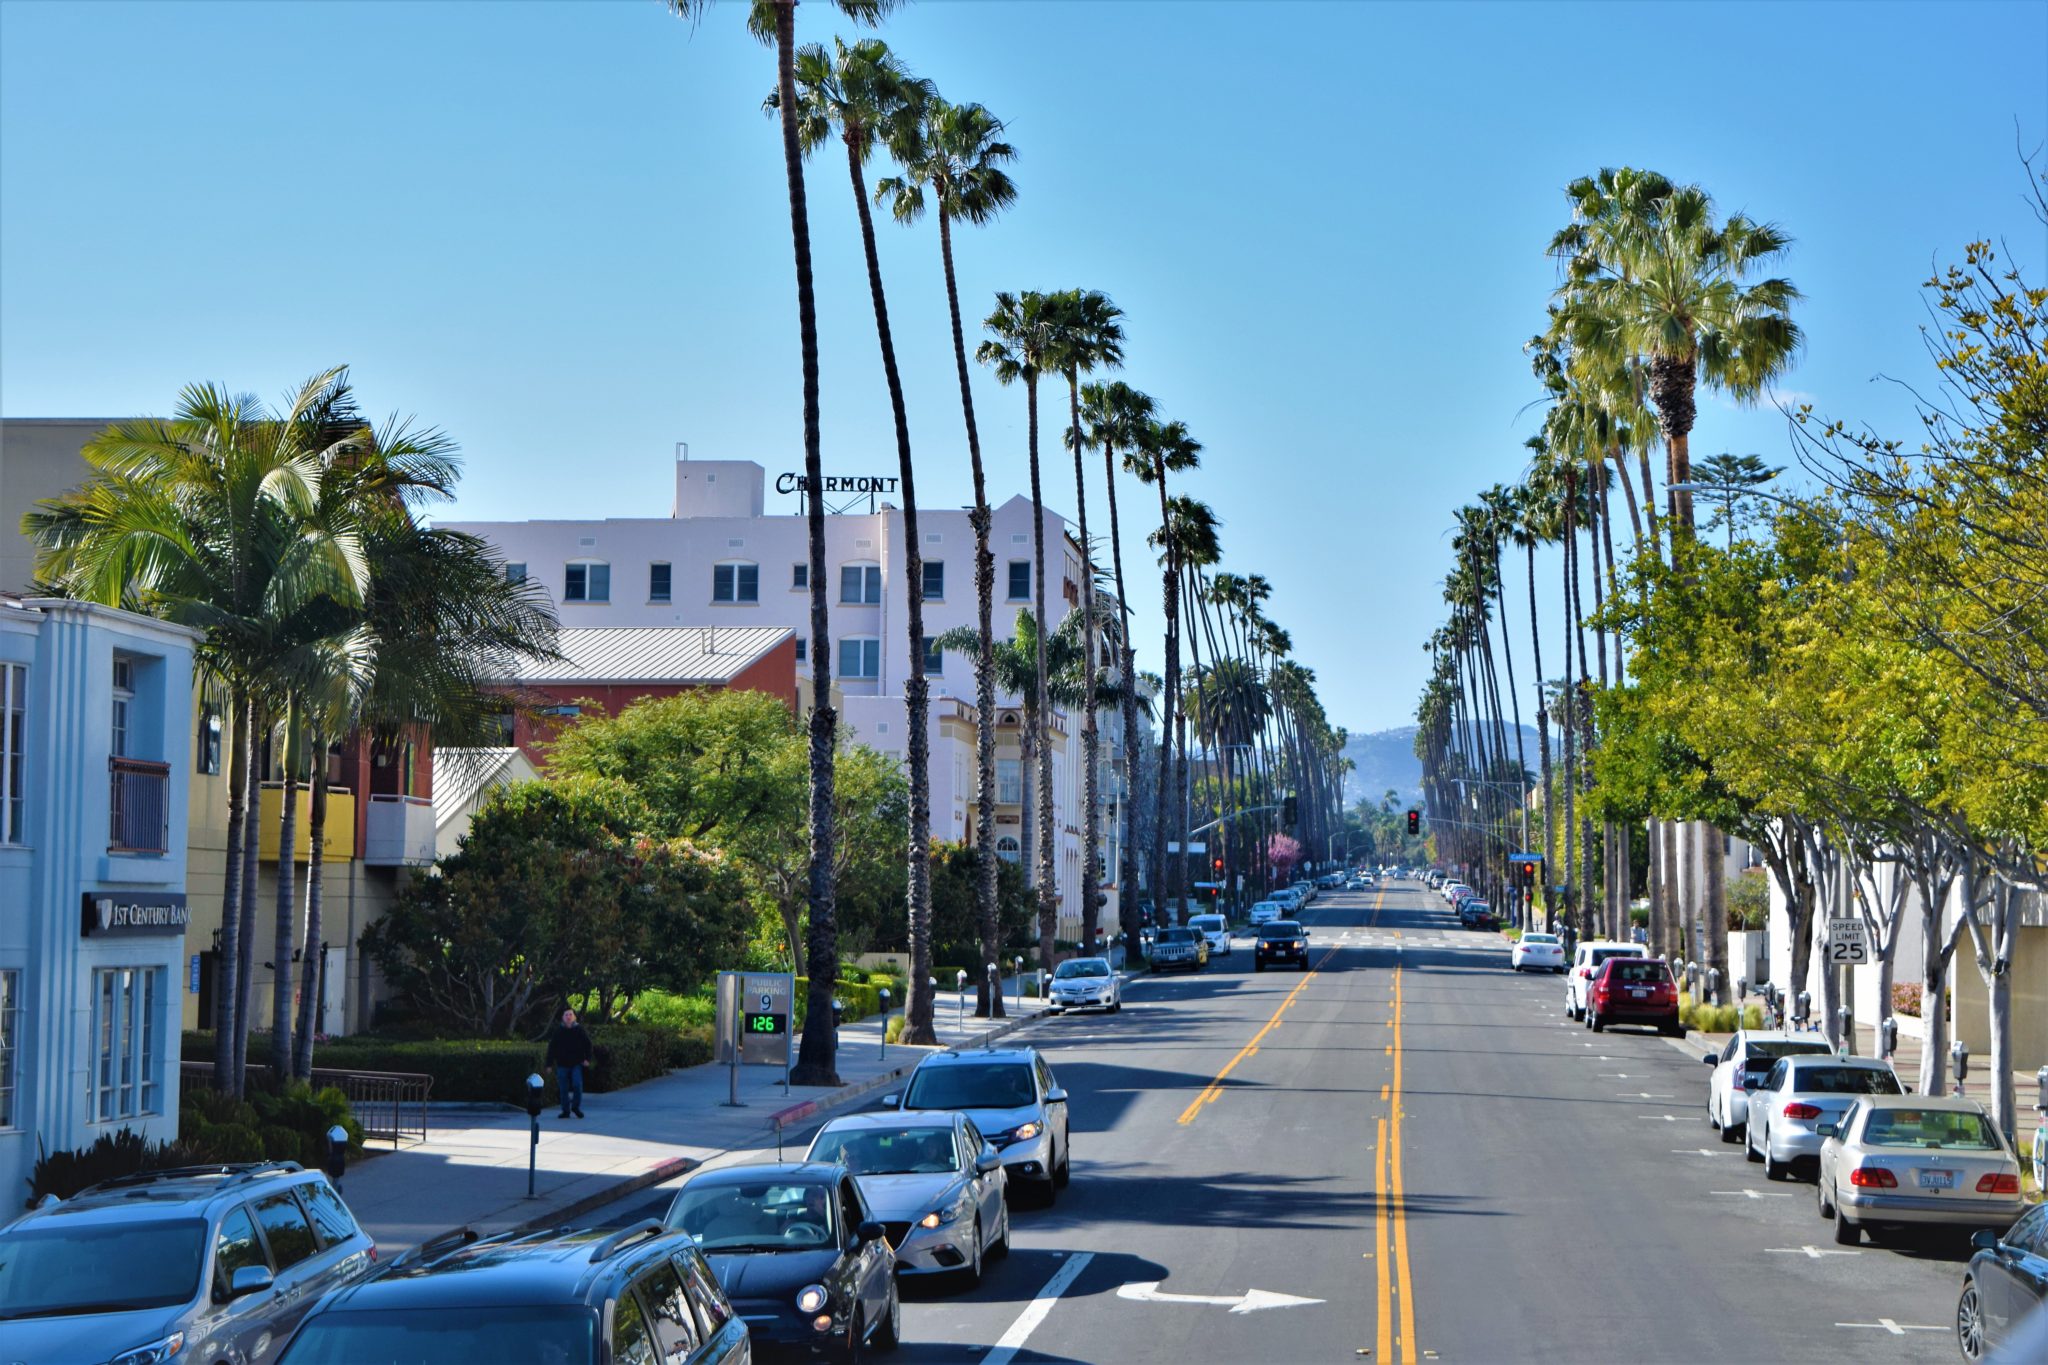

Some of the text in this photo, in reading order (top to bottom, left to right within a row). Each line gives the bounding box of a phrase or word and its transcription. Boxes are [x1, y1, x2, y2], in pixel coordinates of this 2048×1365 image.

[776, 472, 898, 494] CHRMONT
[114, 904, 192, 925] 1ST CENTURY BANK
[1832, 923, 1863, 931] SPEED
[1836, 933, 1860, 941] LIMIT
[1834, 943, 1863, 960] 25
[752, 978, 782, 987] PUBLIC
[747, 986, 785, 995] PARKING
[761, 995, 772, 1011] 9
[753, 1016, 774, 1031] 126
